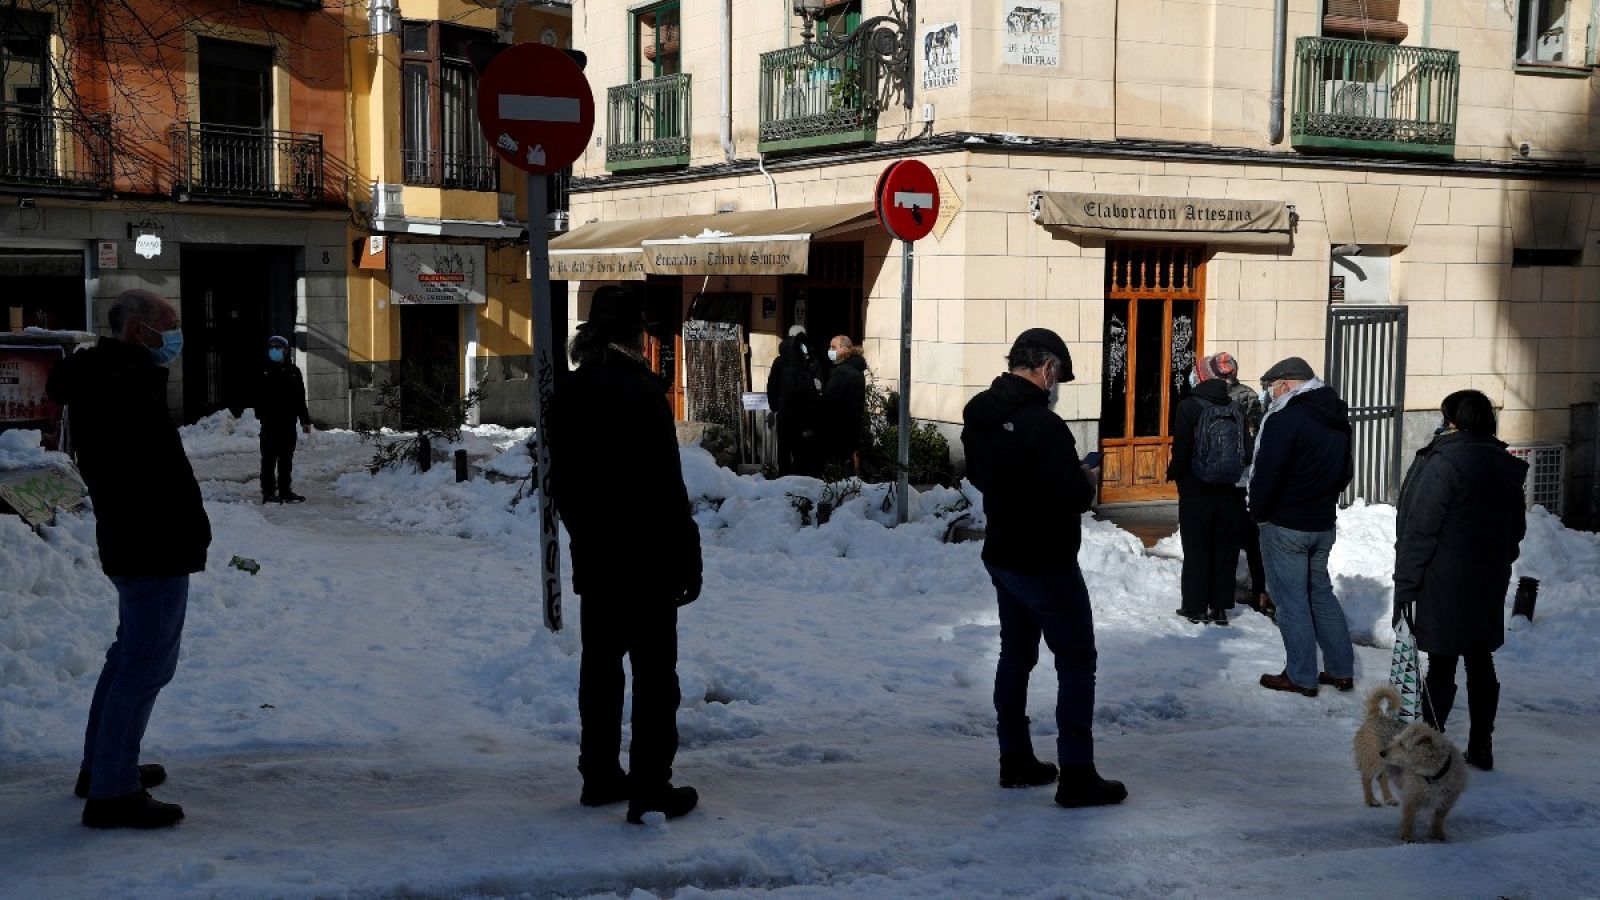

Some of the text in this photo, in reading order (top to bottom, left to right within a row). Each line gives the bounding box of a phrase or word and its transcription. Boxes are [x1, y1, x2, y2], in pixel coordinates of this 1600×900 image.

[1030, 34, 1057, 46] CALLE
[1023, 43, 1040, 54] LAS
[1084, 202, 1253, 221] Elaboración Artesana
[322, 250, 330, 265] 8
